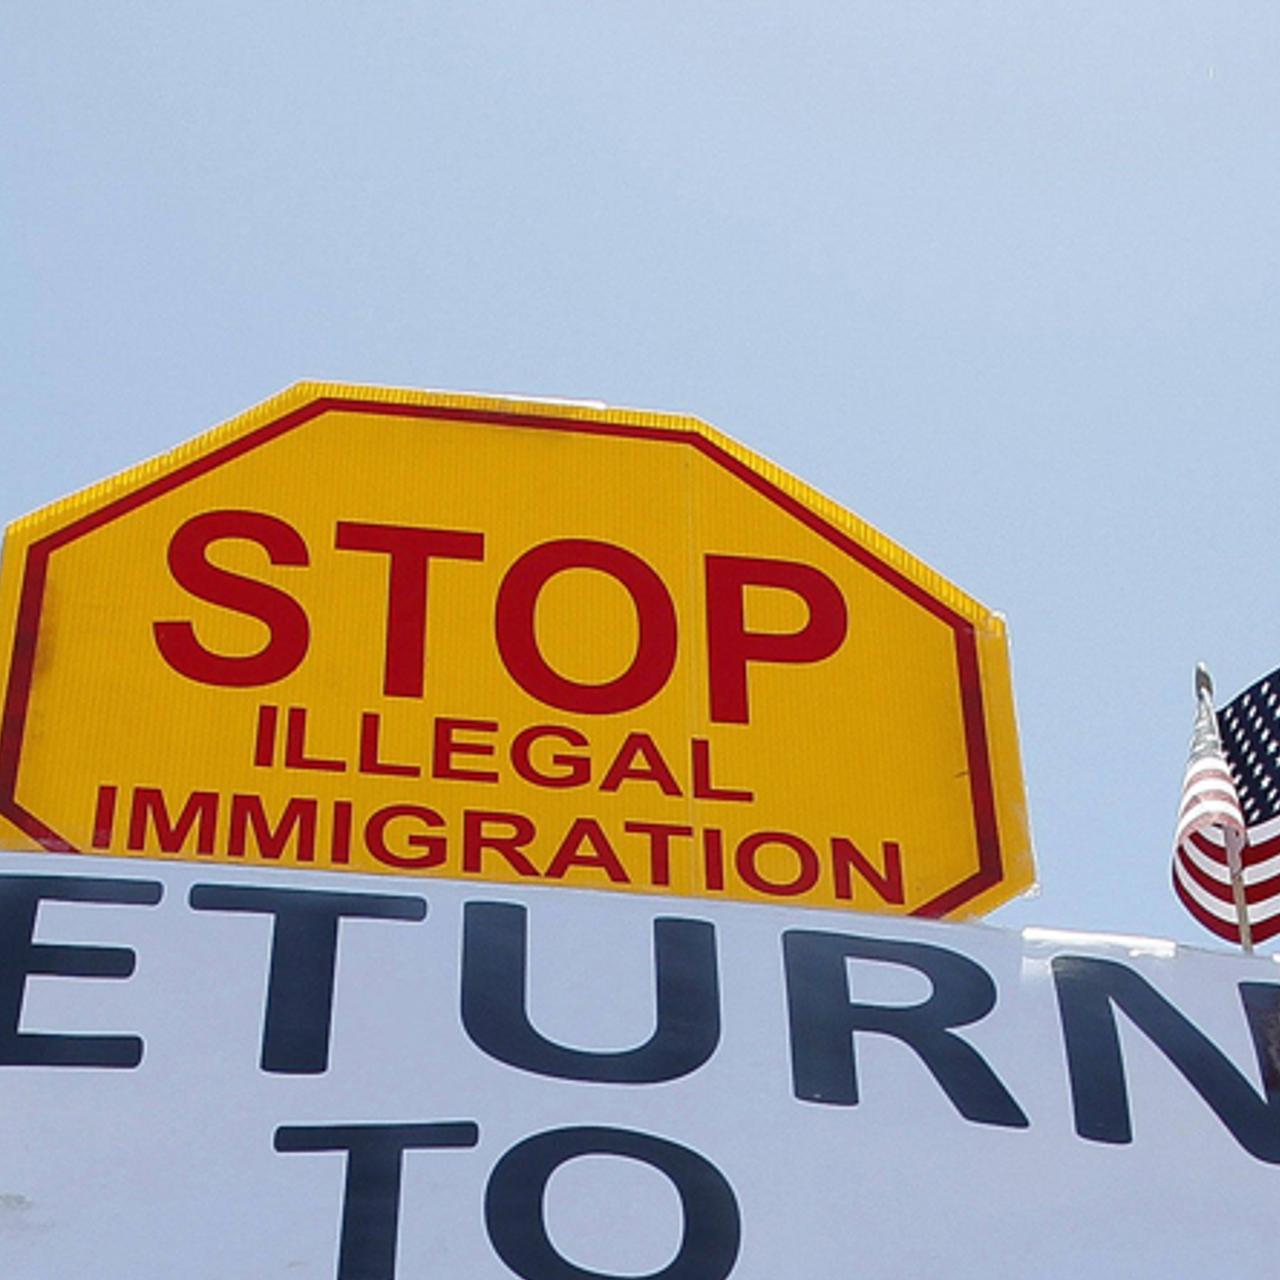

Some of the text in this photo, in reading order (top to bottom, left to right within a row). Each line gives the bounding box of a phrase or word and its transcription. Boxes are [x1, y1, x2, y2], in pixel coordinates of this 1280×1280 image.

[151, 508, 849, 726] STOP
[252, 703, 755, 804] ILLEGAL
[90, 784, 907, 906] IMMIGRATION
